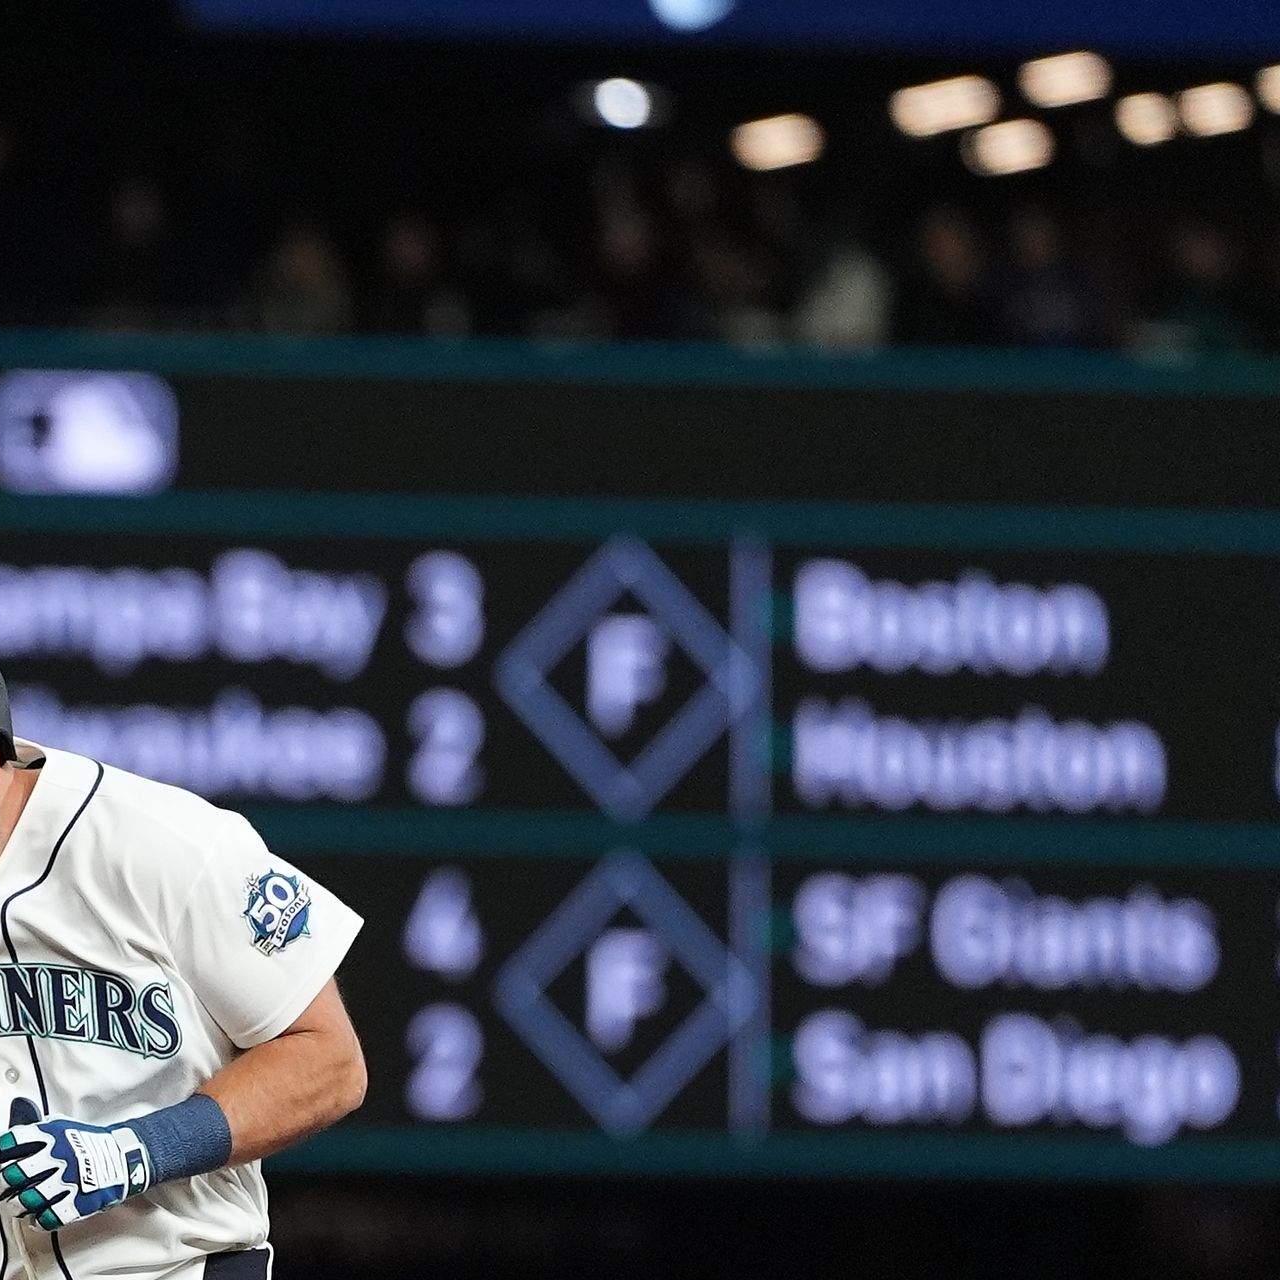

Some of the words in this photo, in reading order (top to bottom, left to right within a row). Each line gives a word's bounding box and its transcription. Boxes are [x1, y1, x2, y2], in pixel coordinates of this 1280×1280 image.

[208, 551, 382, 668] Bay
[413, 554, 482, 664] 3
[795, 561, 1107, 671] Boston
[587, 612, 668, 738] F
[412, 692, 482, 801] 2
[795, 709, 1165, 807] Houston
[248, 875, 297, 933] 50
[796, 876, 917, 983] SF
[931, 879, 1214, 987] Giants
[586, 927, 668, 1052] F
[412, 1007, 480, 1118] 2
[795, 1013, 975, 1121] San
[982, 1016, 1237, 1142] Diego
